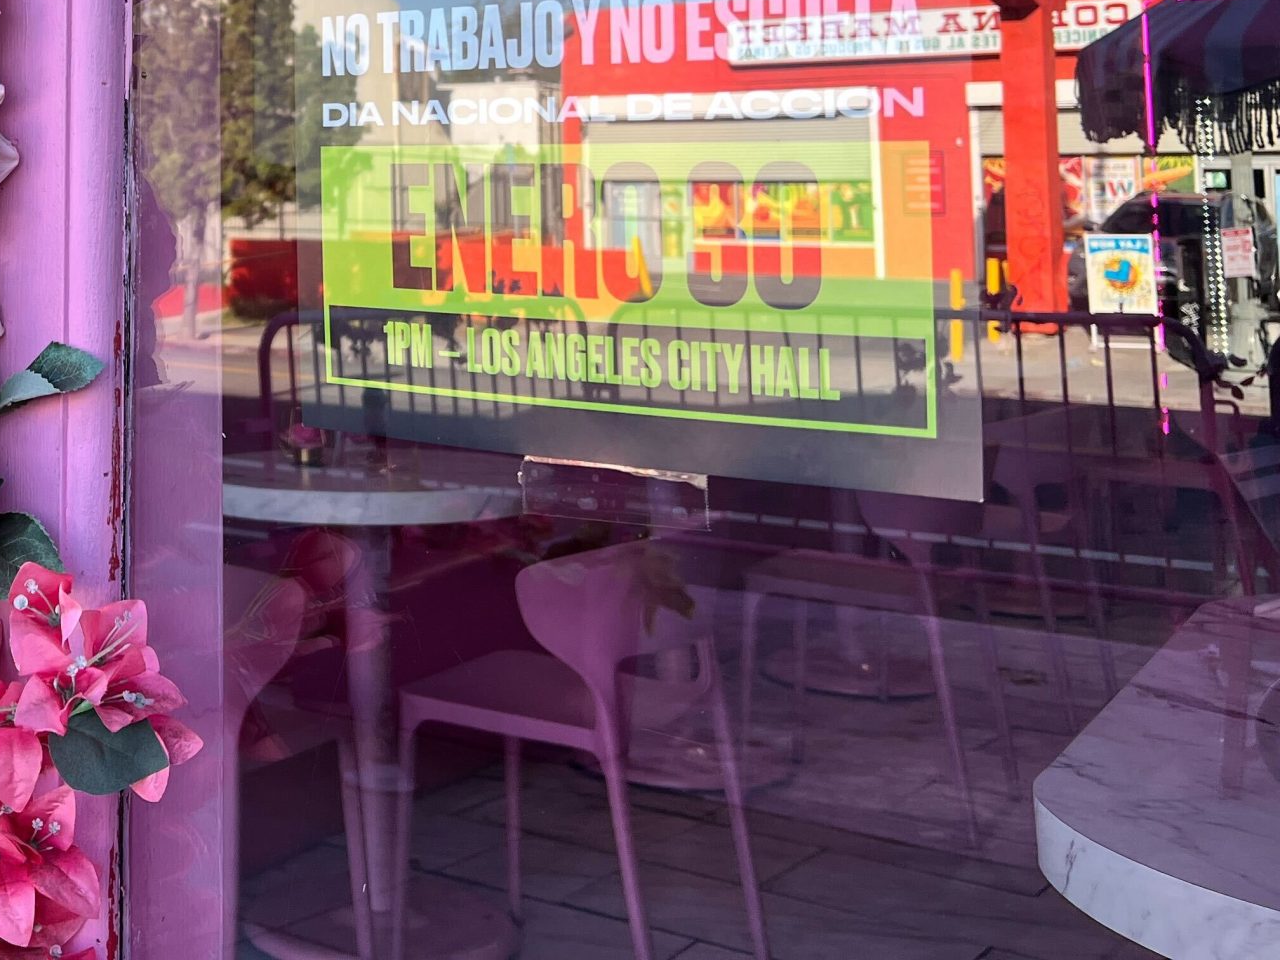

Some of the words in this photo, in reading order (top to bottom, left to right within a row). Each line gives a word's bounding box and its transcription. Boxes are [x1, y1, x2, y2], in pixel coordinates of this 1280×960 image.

[322, 13, 370, 77] NO
[322, 100, 384, 129] DIA
[391, 92, 616, 126] NACIONAL
[626, 91, 694, 122] DE
[704, 86, 924, 120] ACCION
[390, 160, 664, 303] ENERO
[686, 160, 823, 310] 30
[383, 321, 433, 370] 1PM
[465, 325, 521, 376] LOS
[526, 331, 662, 389] ANGELES
[668, 342, 742, 395] CITY
[751, 349, 841, 401] HALL
